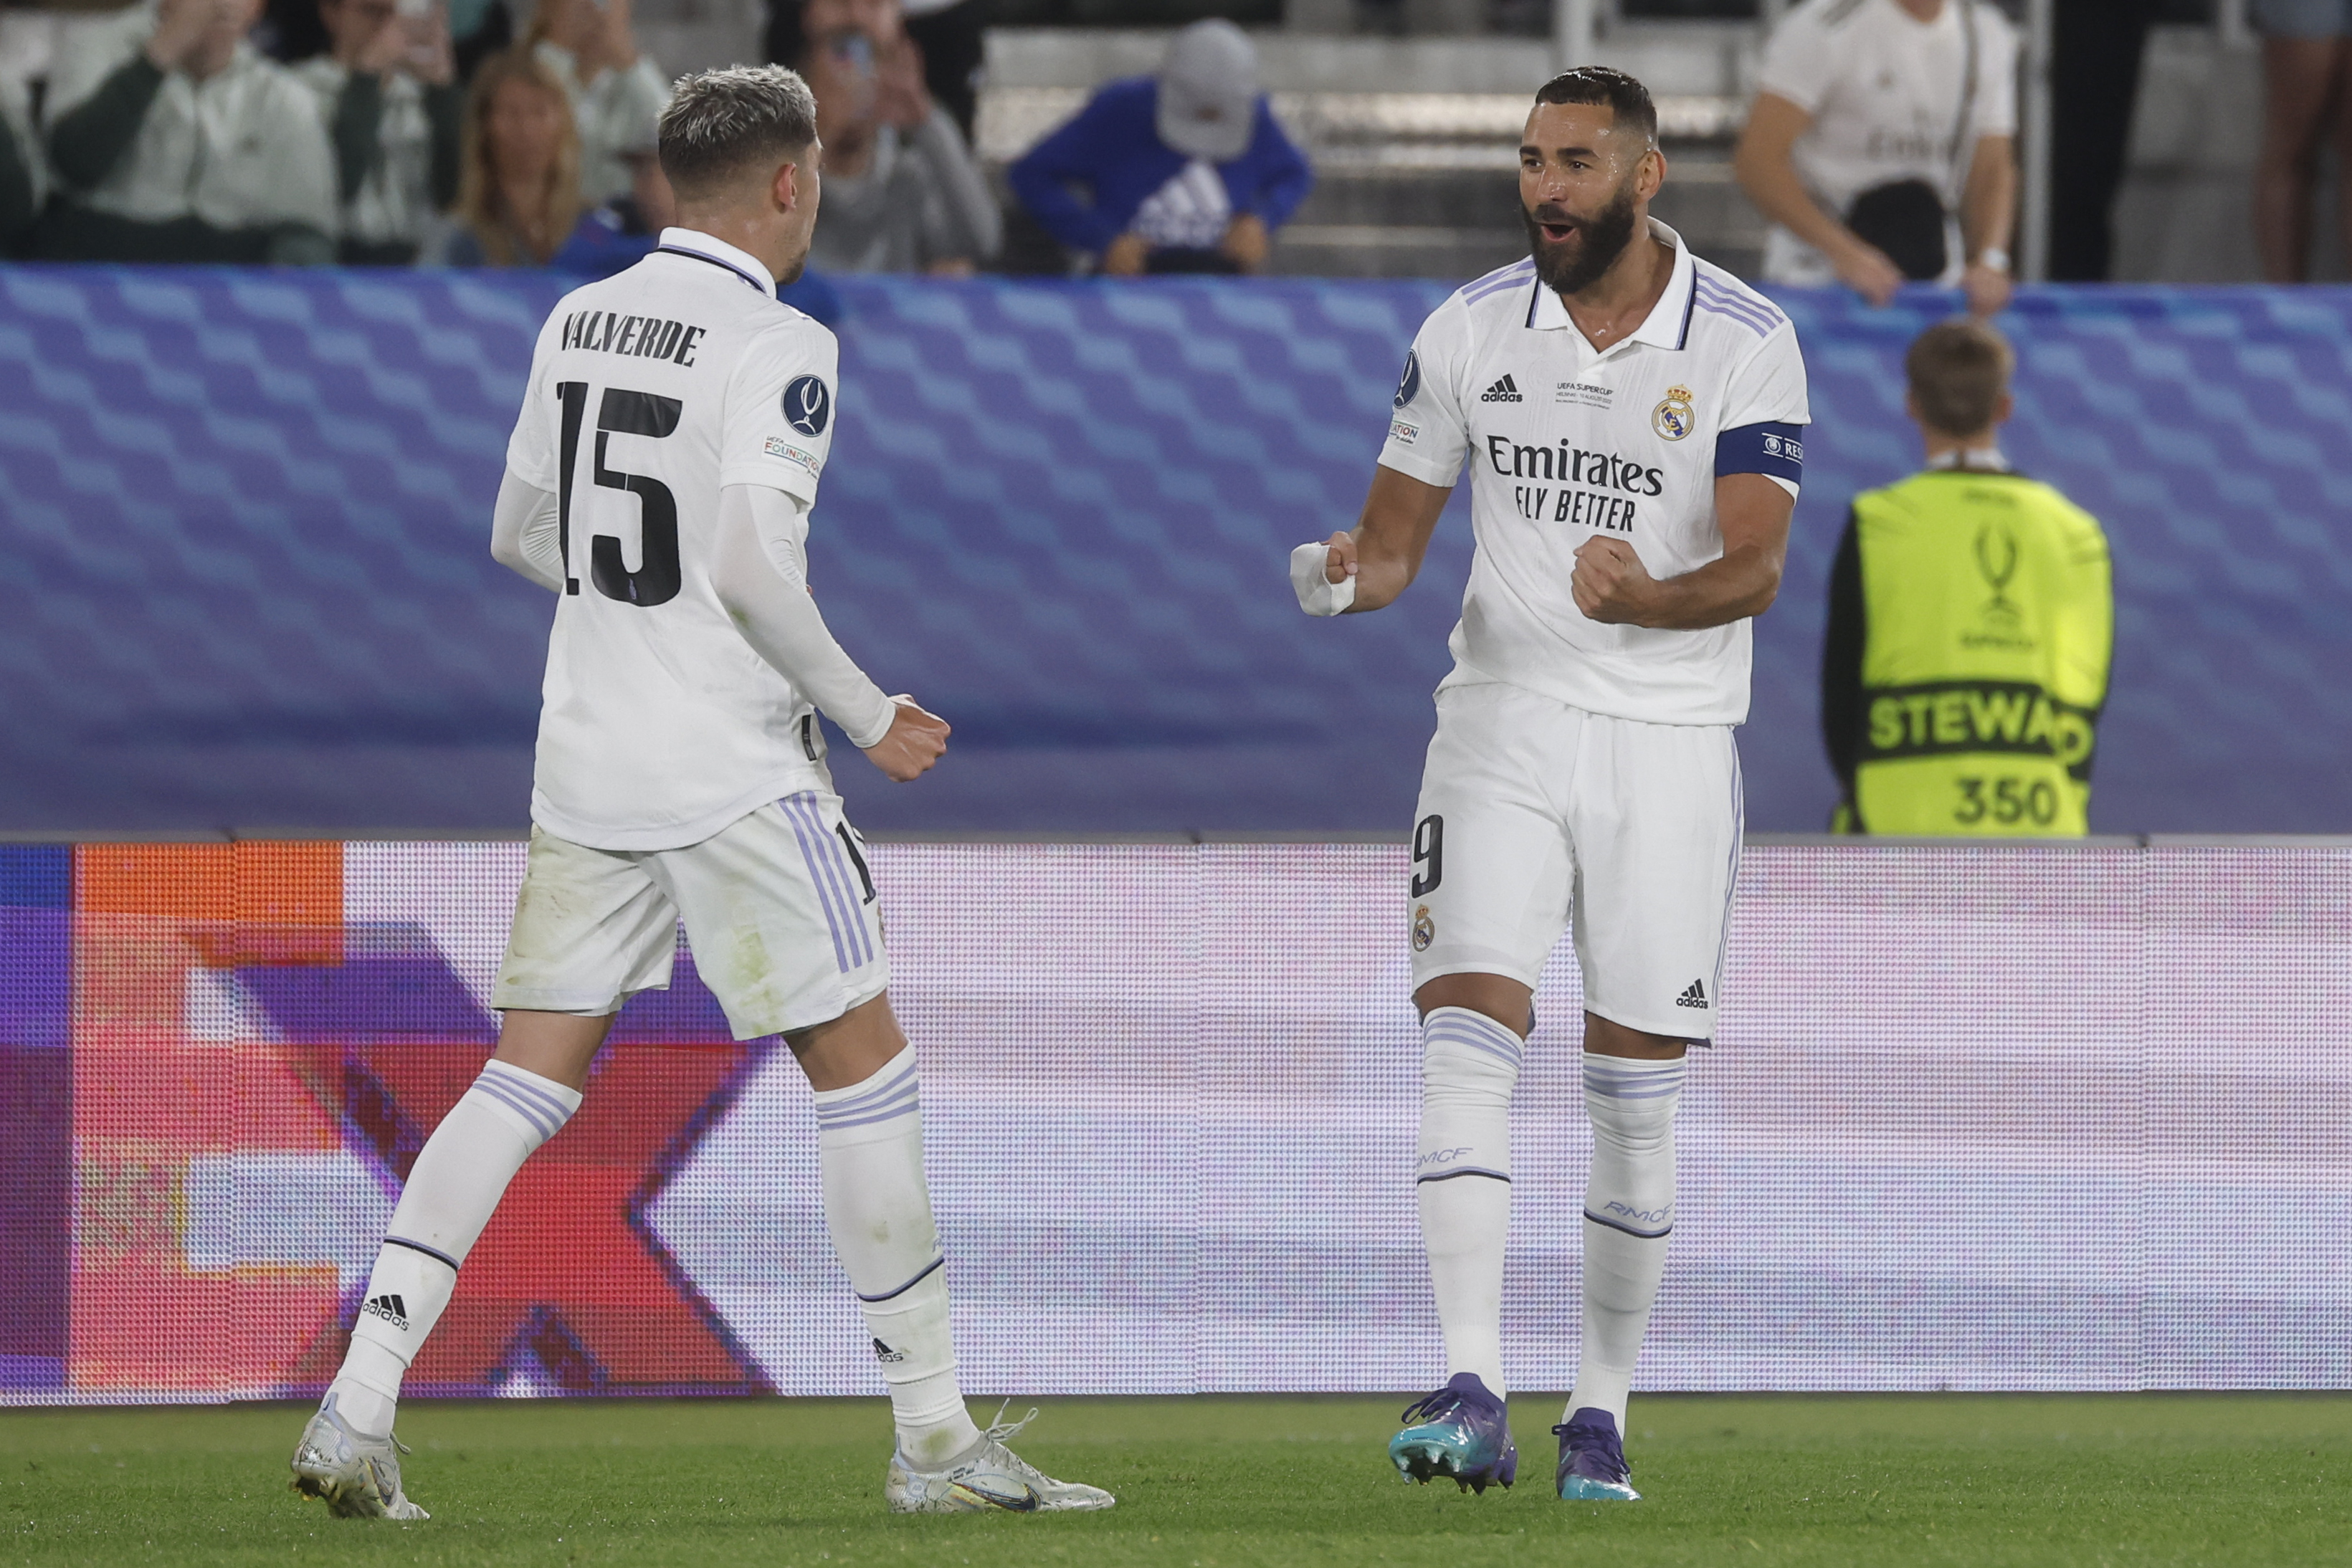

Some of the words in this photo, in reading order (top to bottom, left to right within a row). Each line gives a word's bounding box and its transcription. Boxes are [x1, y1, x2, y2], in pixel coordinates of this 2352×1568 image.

[561, 311, 706, 368] VALVERDE
[1481, 391, 1523, 402] adidas
[1487, 435, 1663, 496] Emirates
[1785, 443, 1803, 459] RES
[556, 381, 682, 607] 15
[1515, 486, 1548, 520] FLY
[1554, 489, 1635, 532] BETTER
[1954, 776, 2060, 825] 350
[1411, 815, 1444, 899] 9
[1676, 996, 1708, 1009] adidas
[1417, 1148, 1473, 1167] MCF
[363, 1303, 409, 1331] adidas
